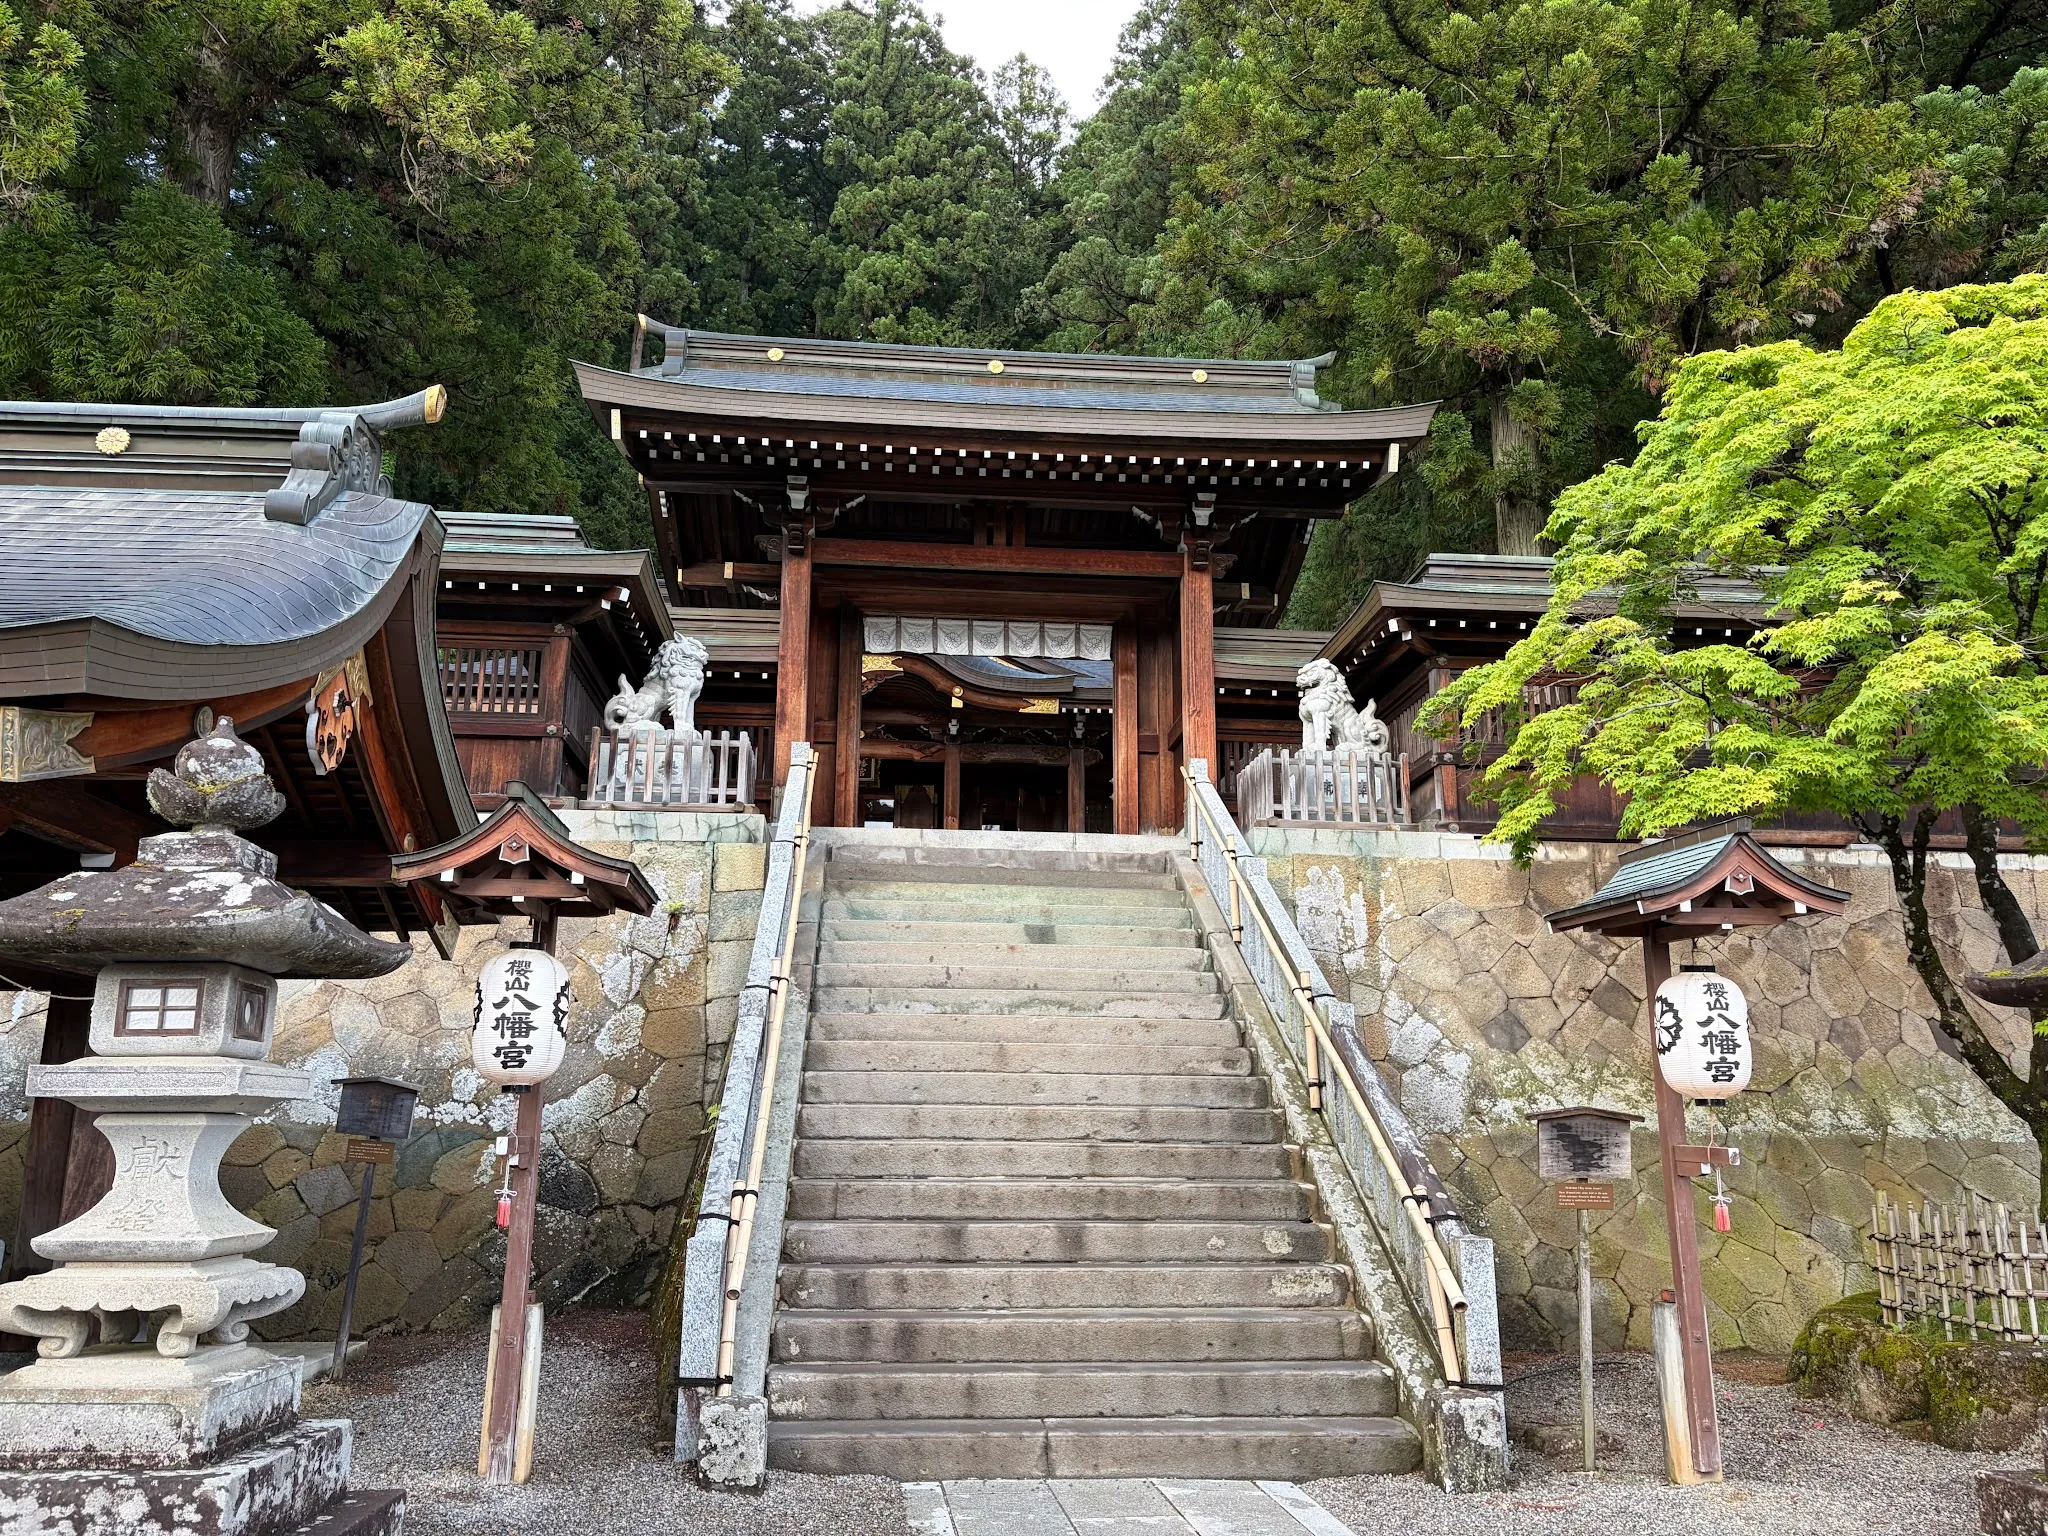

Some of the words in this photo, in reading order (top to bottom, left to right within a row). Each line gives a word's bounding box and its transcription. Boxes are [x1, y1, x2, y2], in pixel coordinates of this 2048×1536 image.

[491, 959, 542, 1070] 櫻山八幡宮
[1696, 982, 1742, 1083] 櫻山八幡宮
